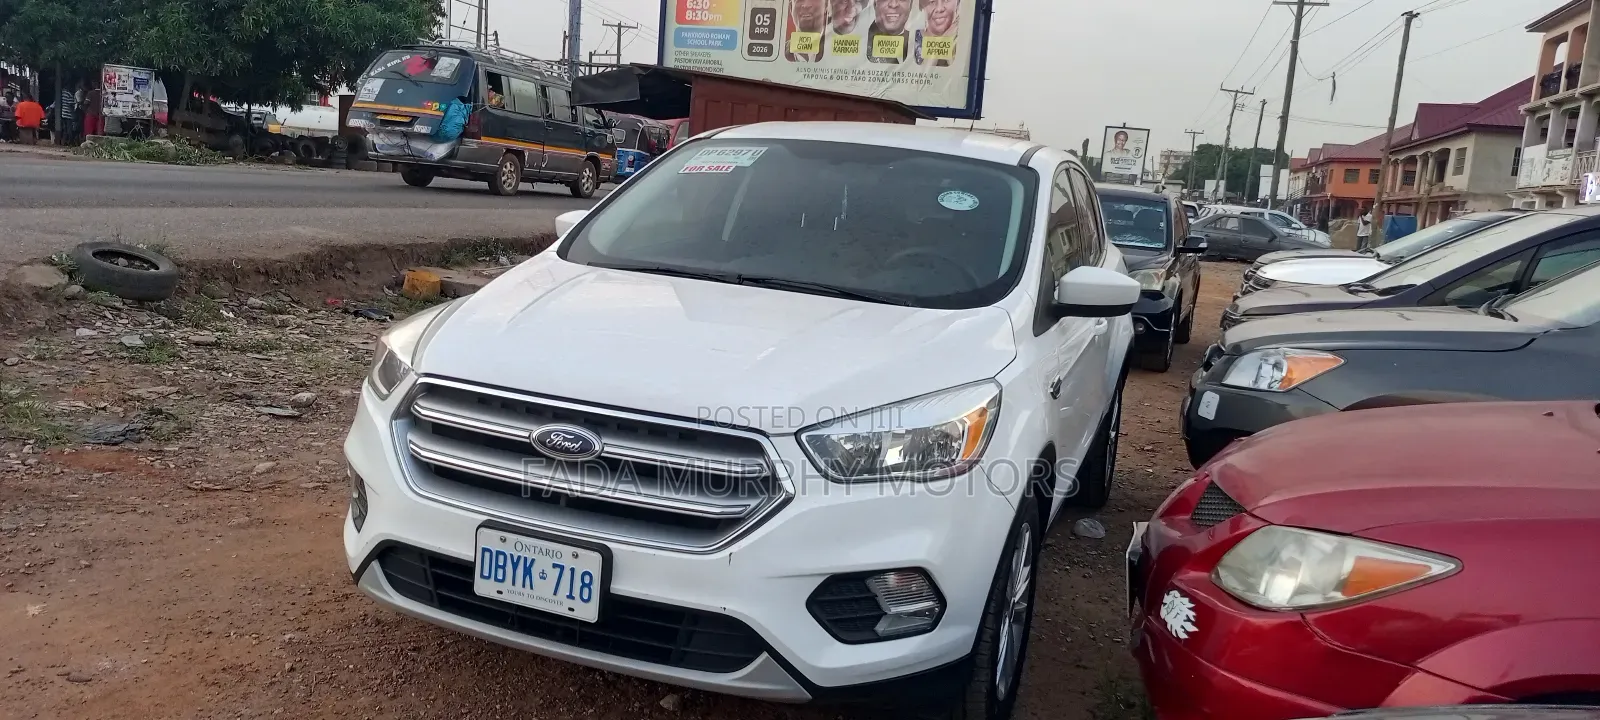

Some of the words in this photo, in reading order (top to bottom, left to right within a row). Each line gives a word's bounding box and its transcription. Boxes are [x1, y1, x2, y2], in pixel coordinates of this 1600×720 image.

[755, 14, 771, 26] 05
[755, 27, 769, 35] APR
[927, 48, 949, 56] APPIAH
[546, 431, 583, 452] Ford
[480, 546, 536, 590] DBYK
[552, 562, 594, 604] 718
[527, 592, 536, 600] TO
